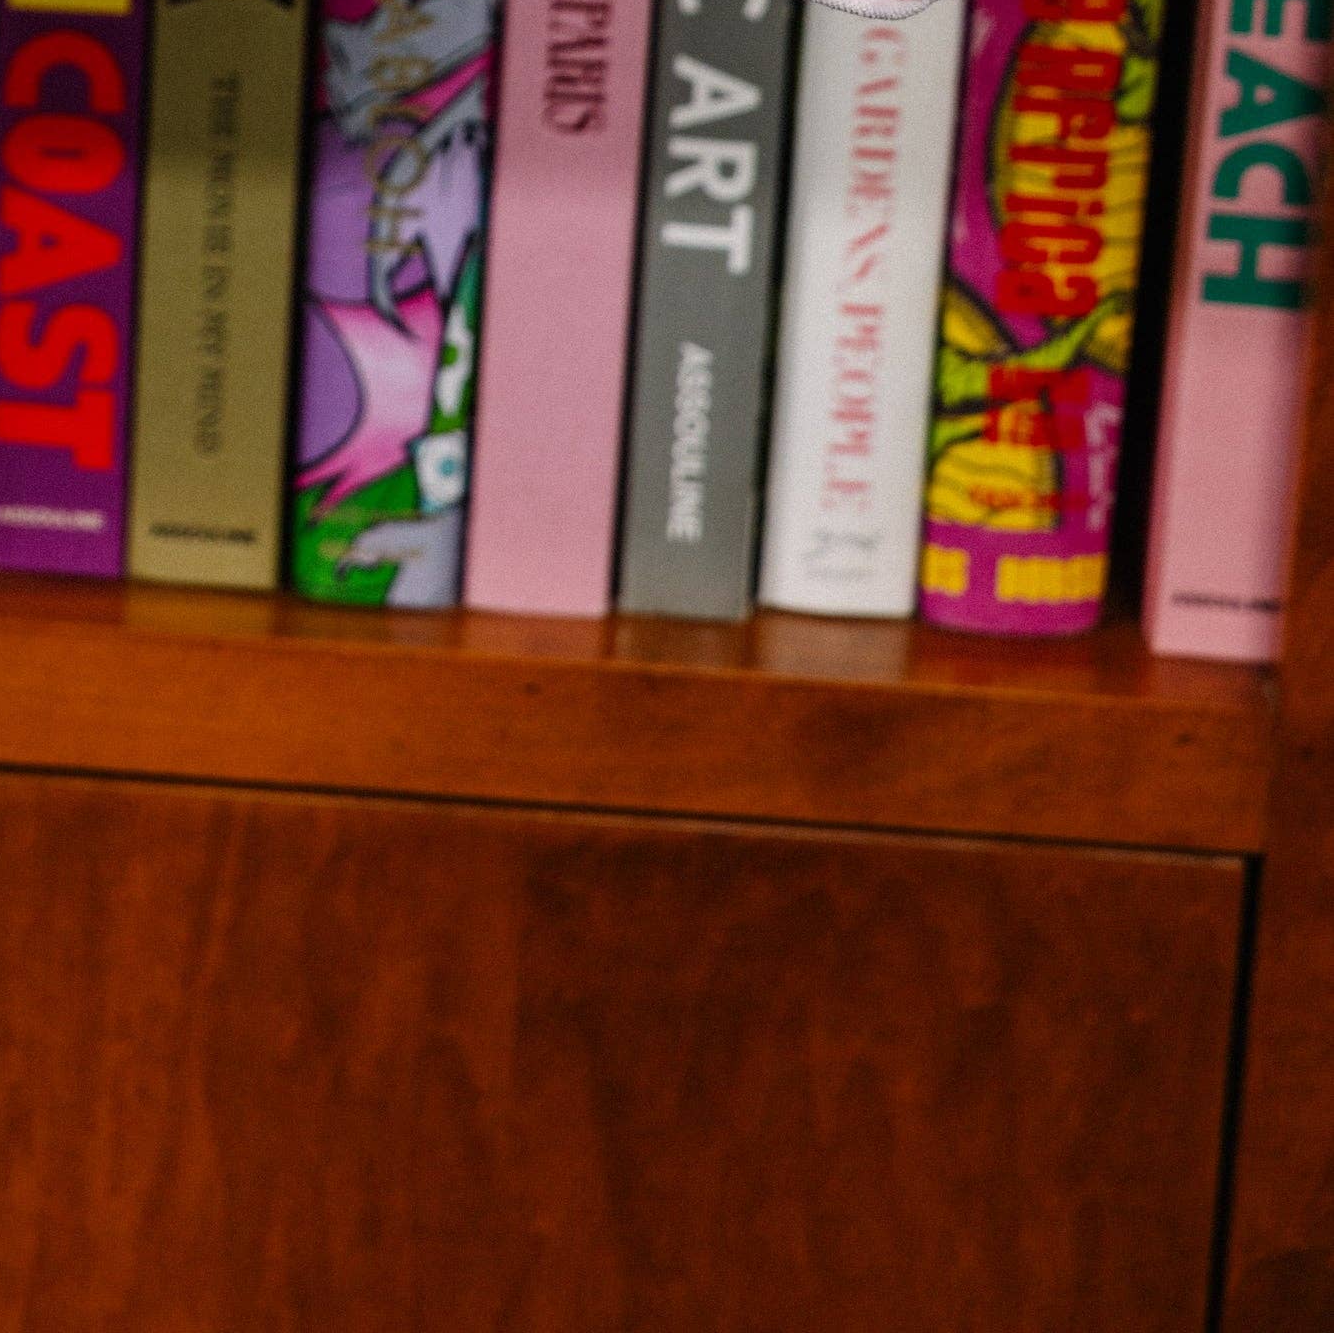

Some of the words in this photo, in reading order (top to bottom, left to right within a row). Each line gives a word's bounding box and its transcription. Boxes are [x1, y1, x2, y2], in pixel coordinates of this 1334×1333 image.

[661, 54, 763, 277] ART
[666, 341, 715, 545] ASSOULINE
[820, 301, 887, 513] PEOPLE
